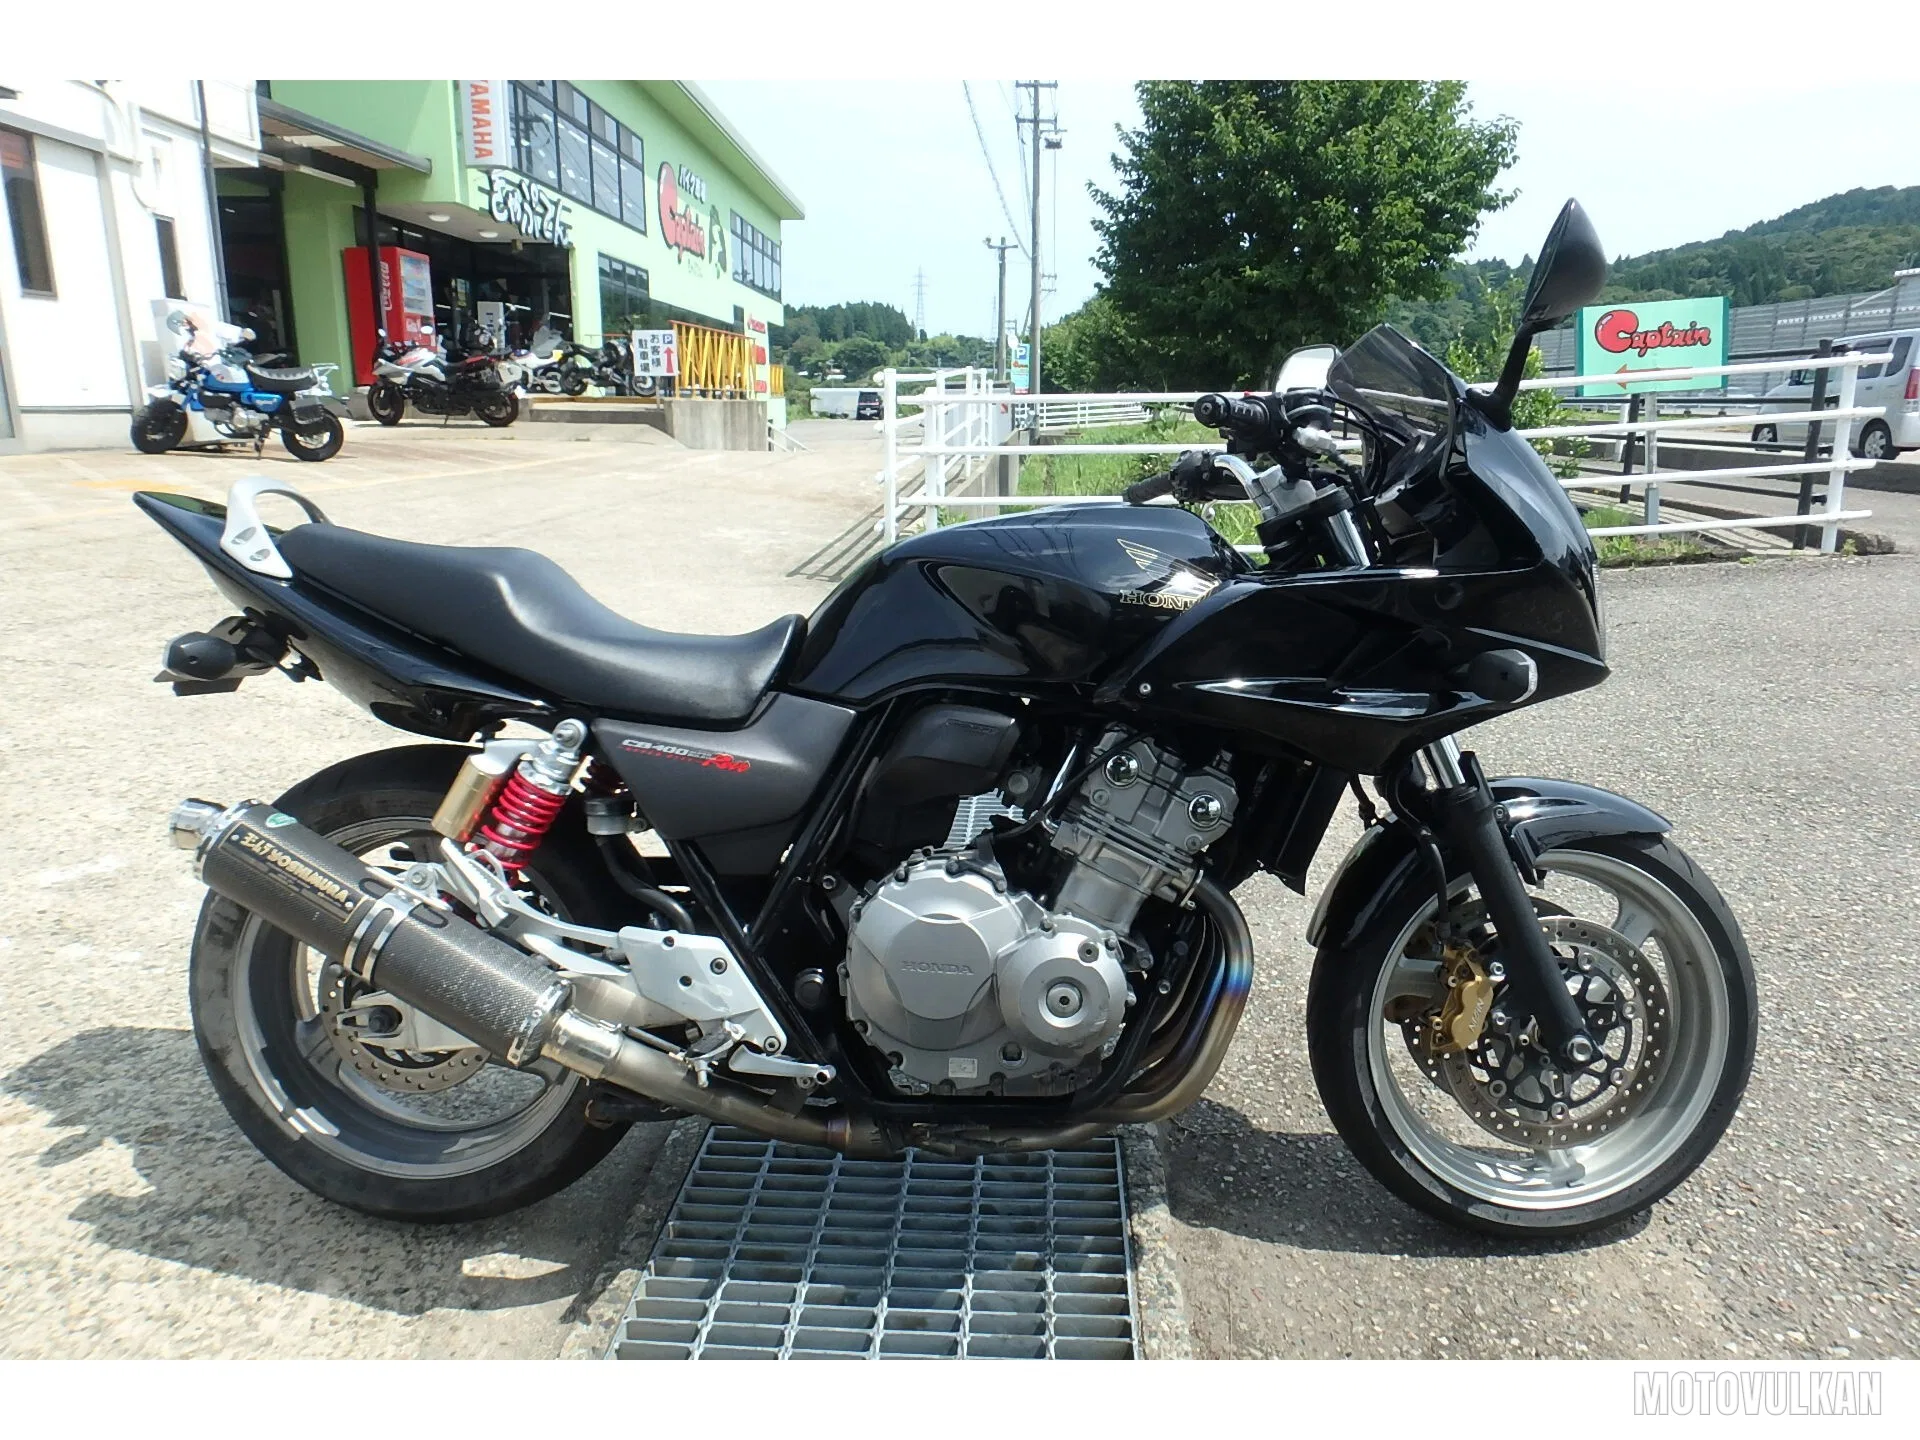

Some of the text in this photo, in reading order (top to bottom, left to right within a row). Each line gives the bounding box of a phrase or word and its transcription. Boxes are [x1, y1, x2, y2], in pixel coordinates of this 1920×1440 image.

[470, 80, 493, 158] AMAHA
[1594, 309, 1712, 358] Captain
[900, 960, 975, 976] HONDA
